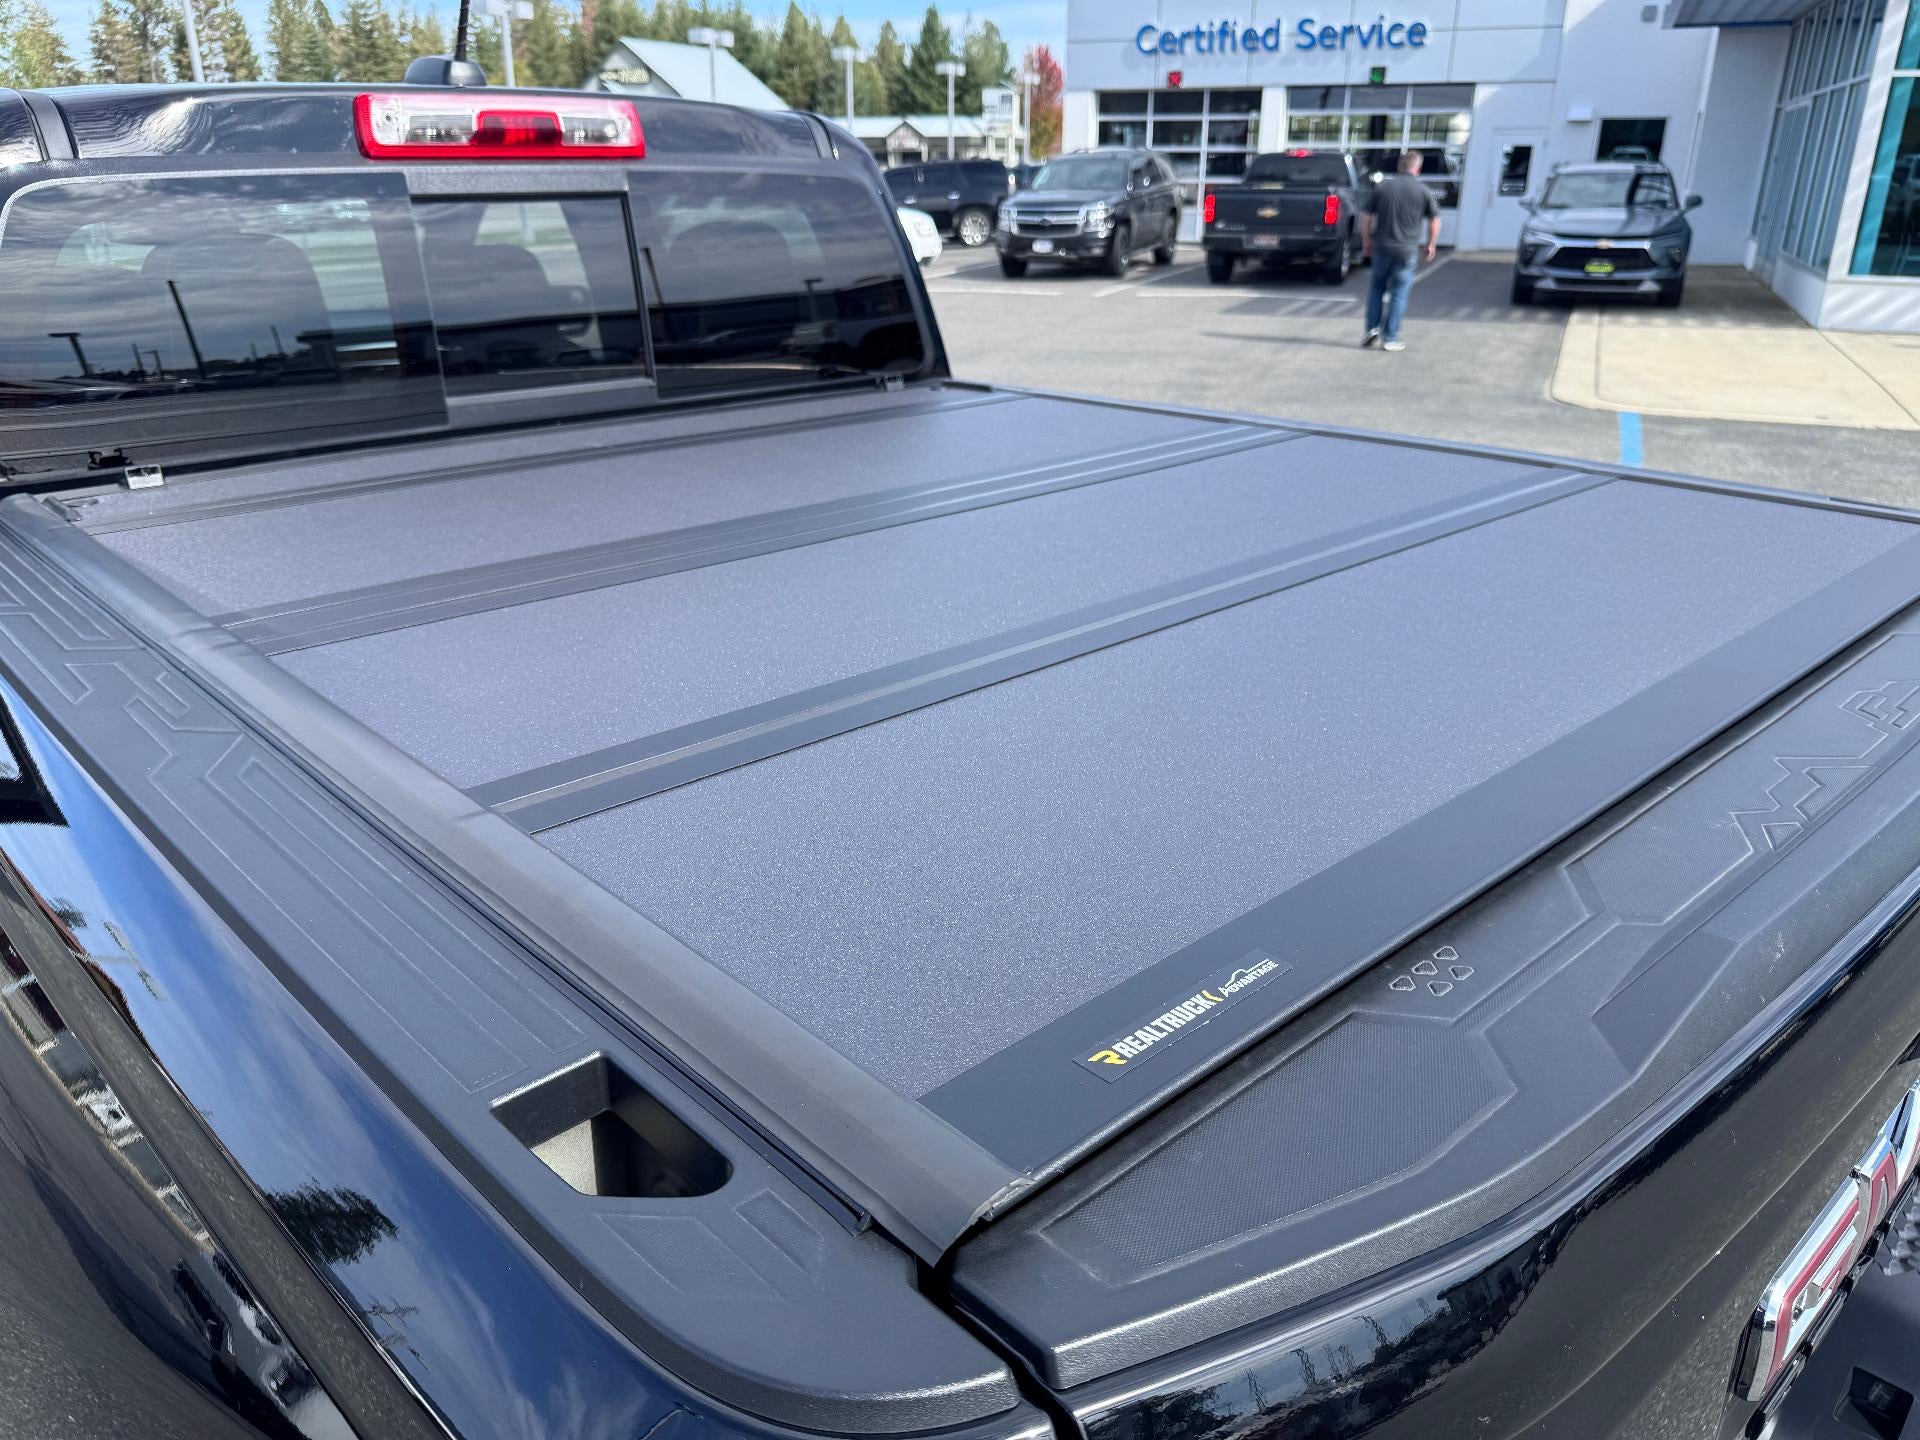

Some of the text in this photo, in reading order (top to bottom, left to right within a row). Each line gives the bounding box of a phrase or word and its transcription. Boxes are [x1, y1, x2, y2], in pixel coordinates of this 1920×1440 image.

[1136, 15, 1427, 56] Certified Service
[1111, 961, 1279, 1059] REALTRUCK ADVANTAGE
